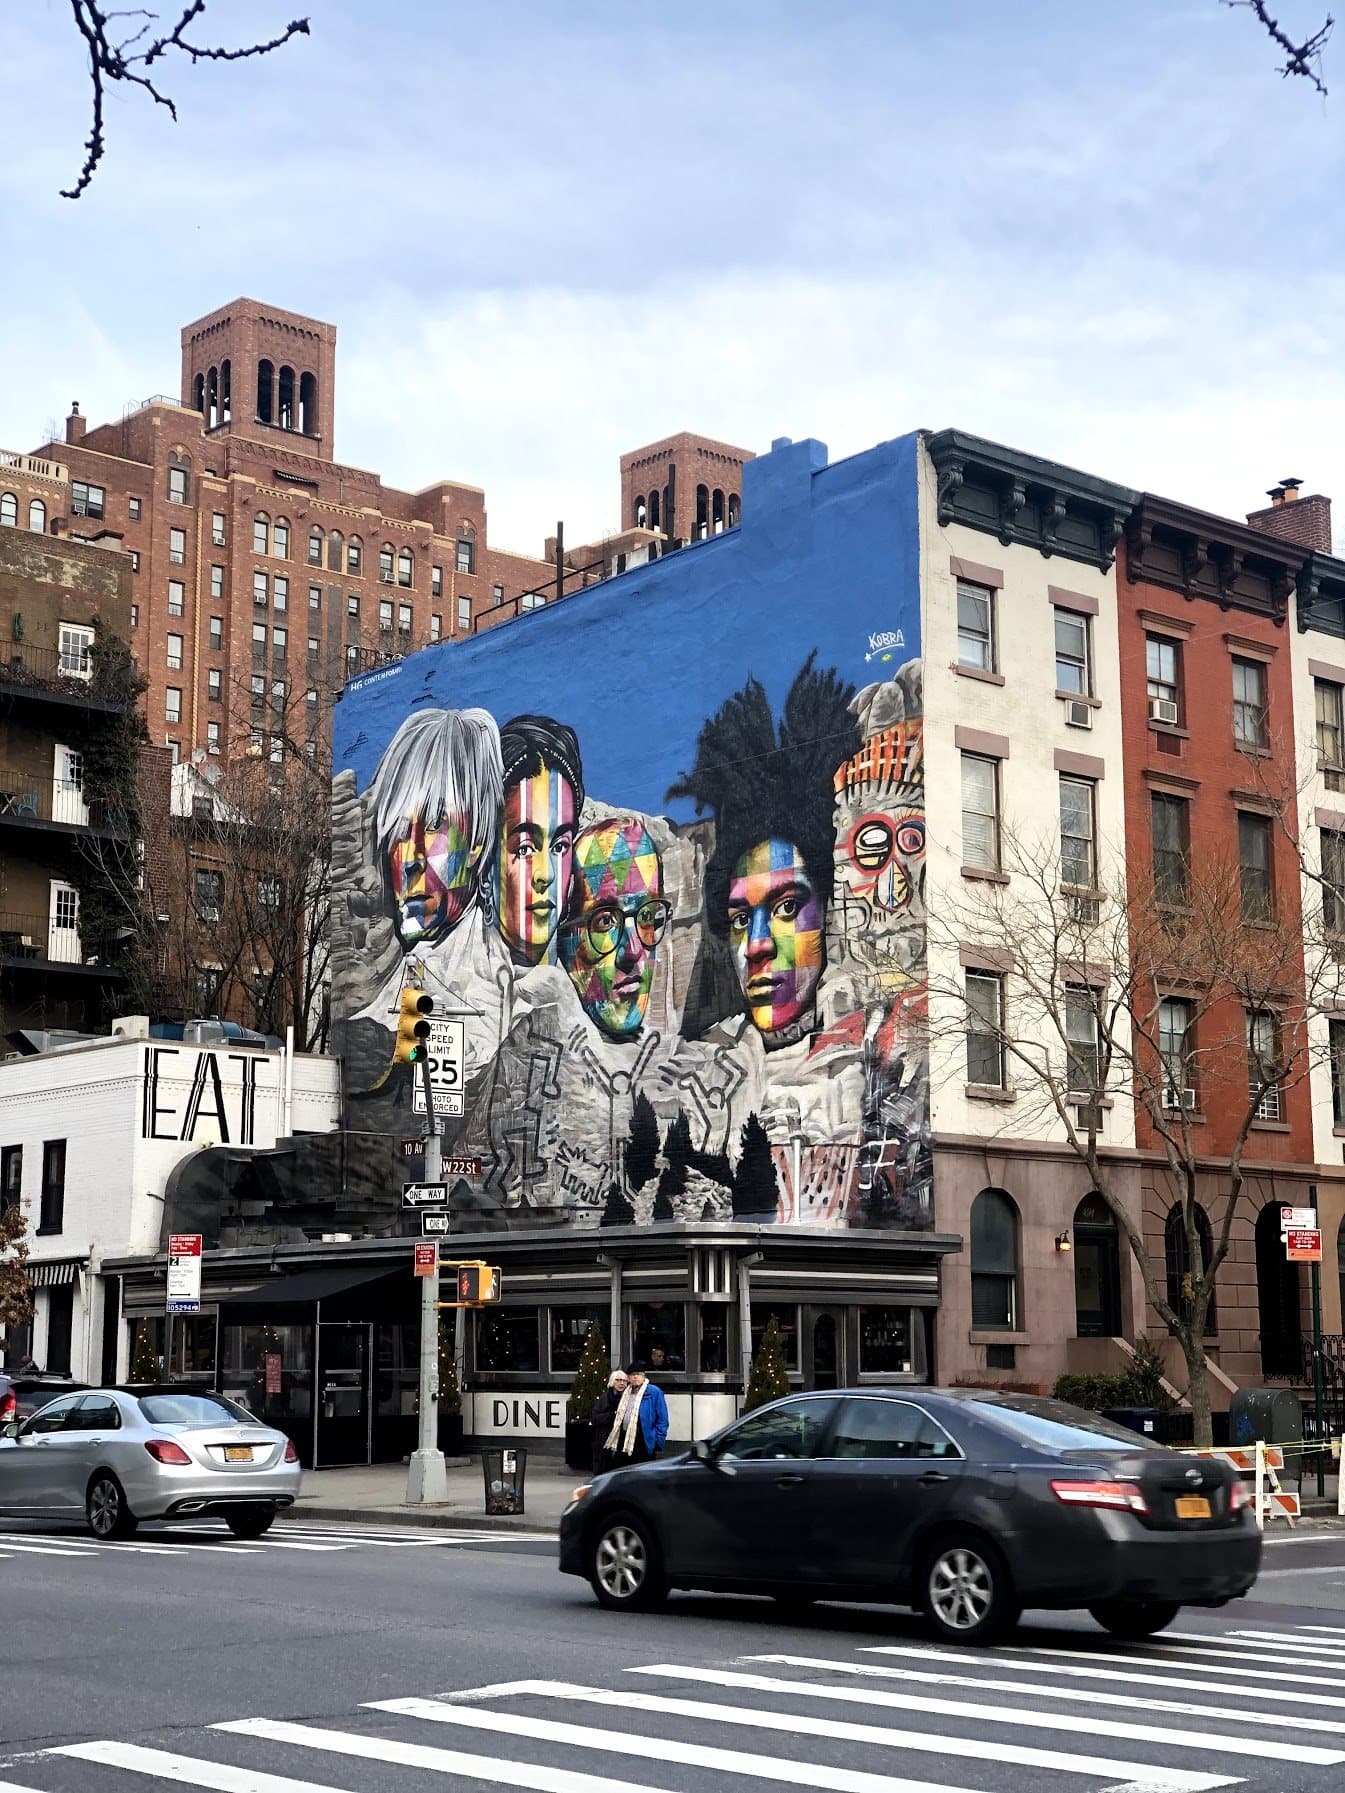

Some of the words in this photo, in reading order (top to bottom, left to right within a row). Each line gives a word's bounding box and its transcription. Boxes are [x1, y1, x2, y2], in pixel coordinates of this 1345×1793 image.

[868, 628, 904, 650] KOBRA
[350, 681, 363, 691] HG
[430, 1023, 450, 1032] CITY
[426, 1034, 454, 1044] SPEED
[429, 1045, 451, 1054] LIMIT
[422, 1057, 458, 1085] 25
[142, 1047, 270, 1145] EAT
[432, 1095, 452, 1103] HOTO
[404, 1143, 413, 1155] 10
[414, 1143, 423, 1154] Av
[443, 1161, 451, 1173] W
[453, 1161, 465, 1174] 22
[466, 1162, 477, 1174] St
[410, 1190, 422, 1200] ONE
[428, 1190, 442, 1199] WAY
[171, 1256, 177, 1266] 2
[493, 1399, 560, 1428] DINE
